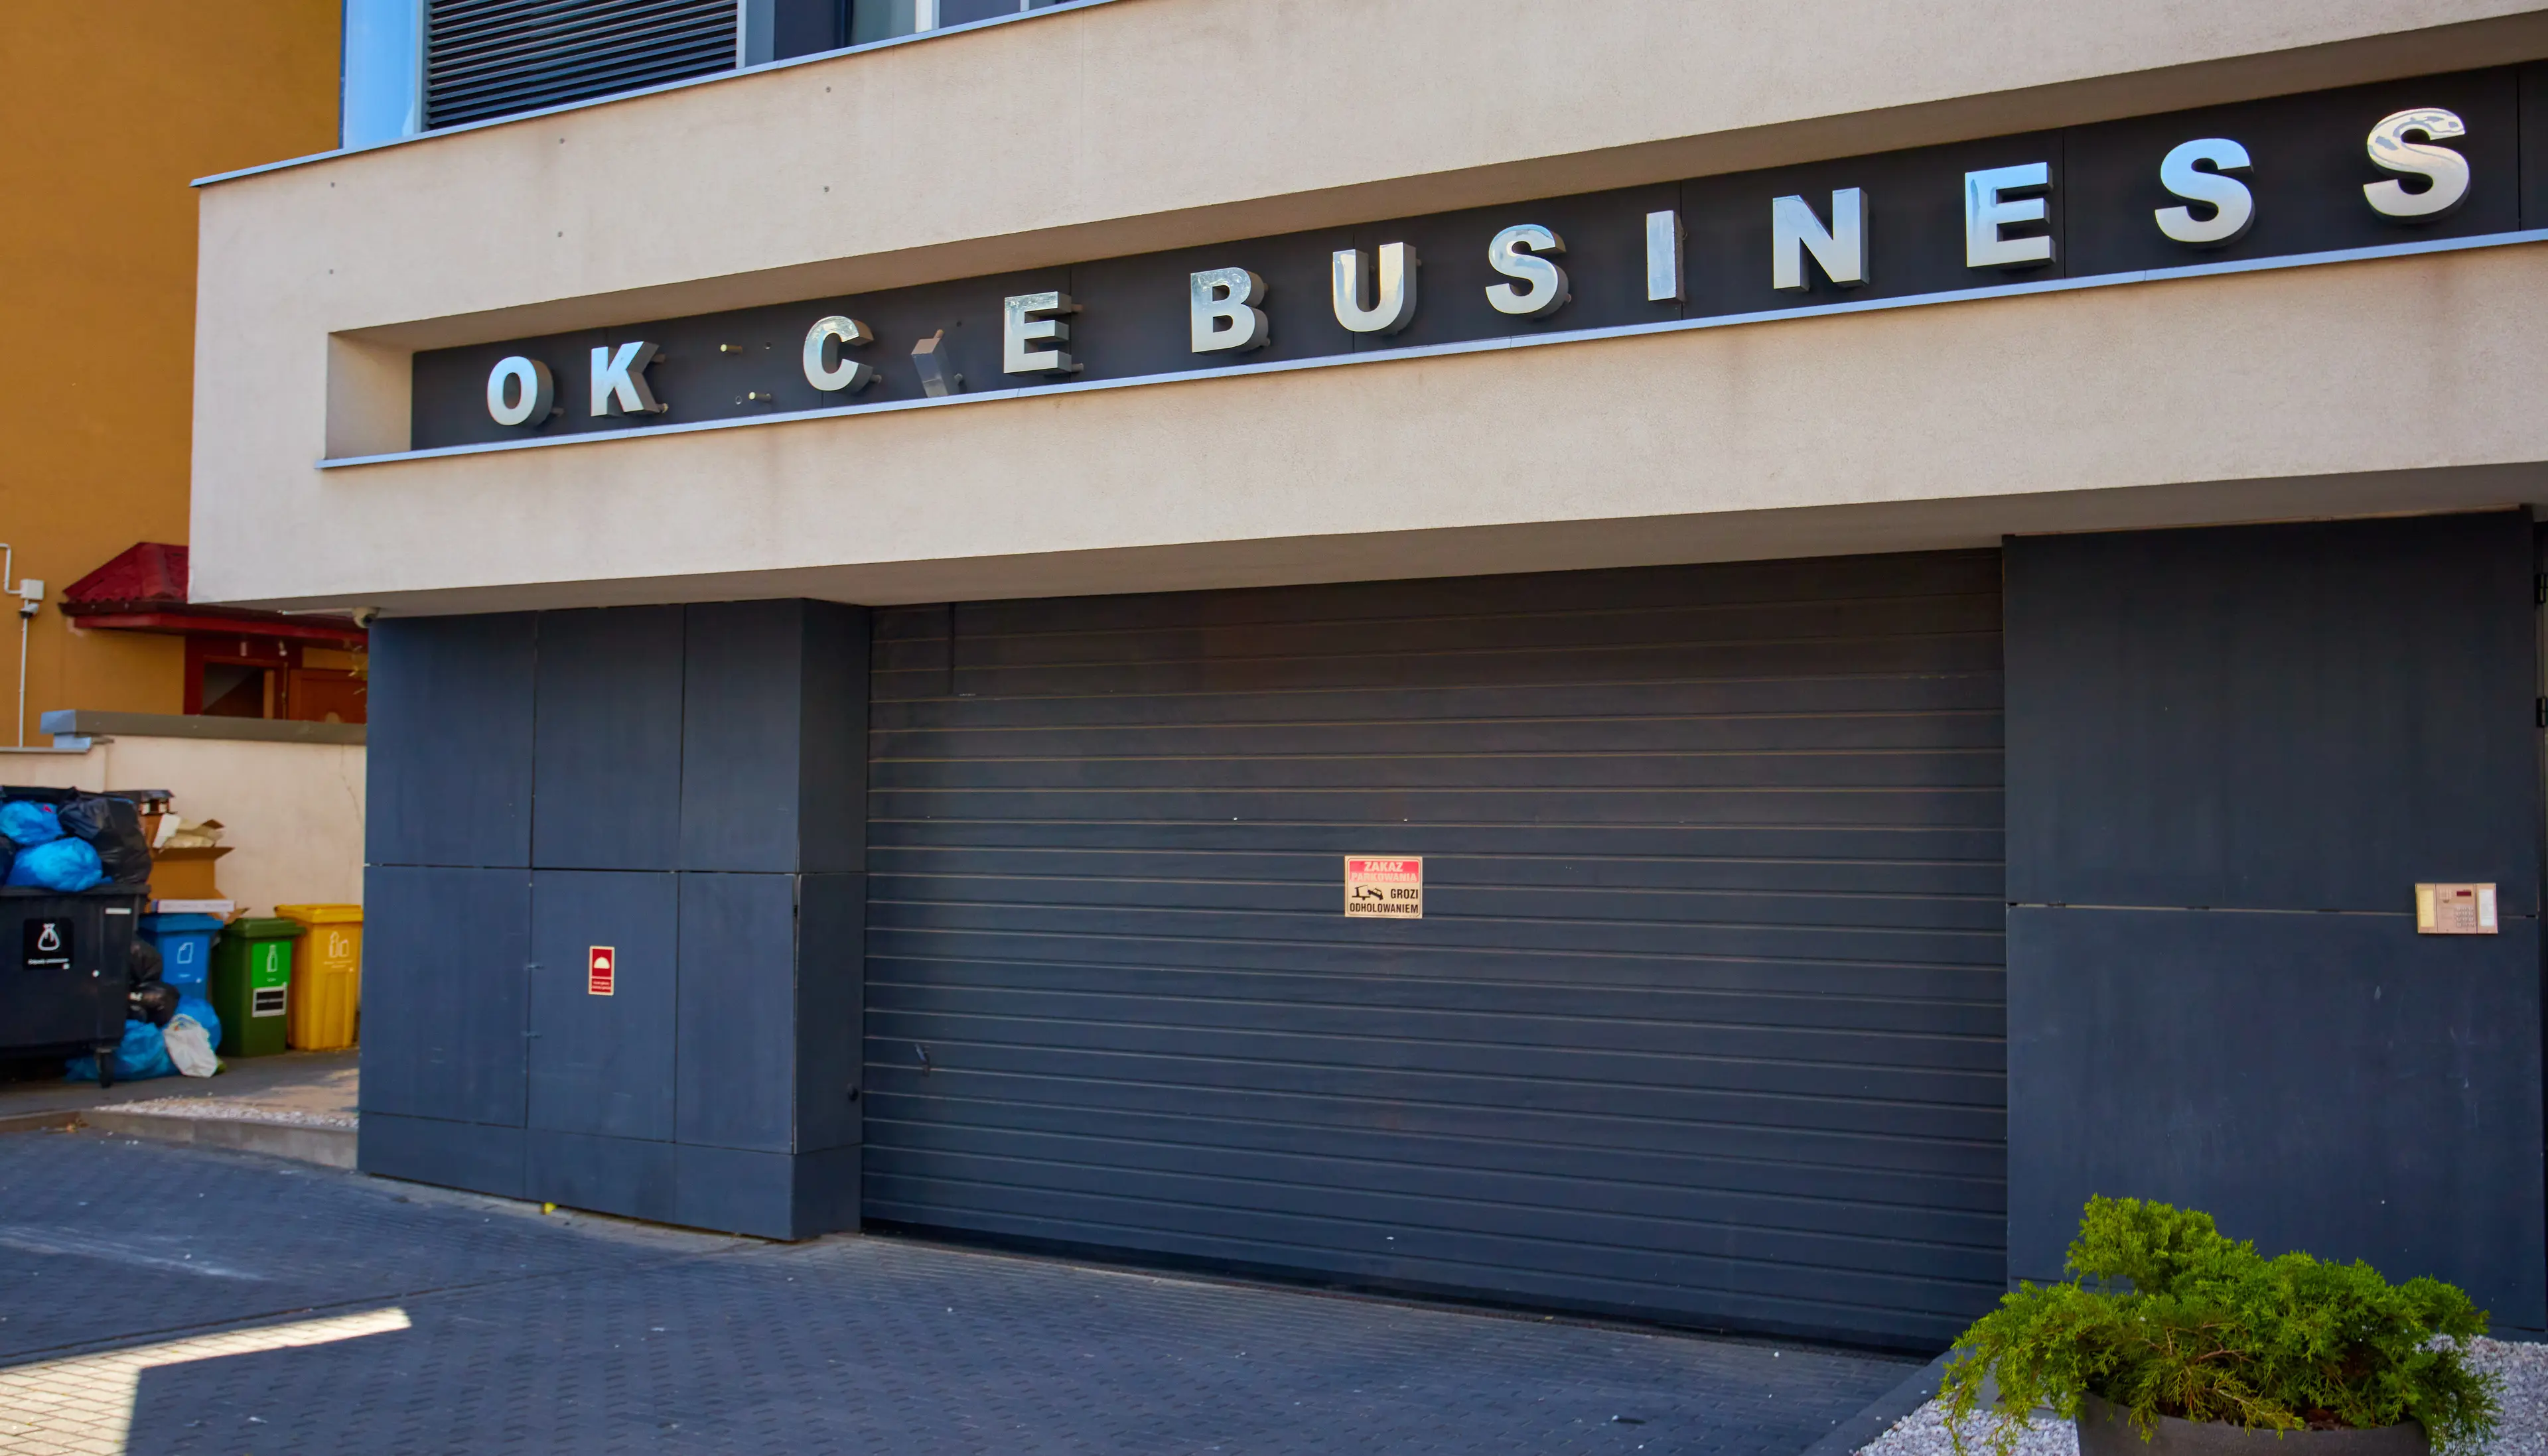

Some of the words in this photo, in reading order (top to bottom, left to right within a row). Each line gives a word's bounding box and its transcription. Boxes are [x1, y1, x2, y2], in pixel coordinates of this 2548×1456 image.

[1190, 107, 2470, 354] BUSINESS
[1364, 862, 1403, 872] ZAKAZ
[1350, 872, 1417, 882] PARKOWANIA
[1390, 888, 1419, 899] GROZI
[1349, 903, 1419, 914] ODHOLOWANIEM
